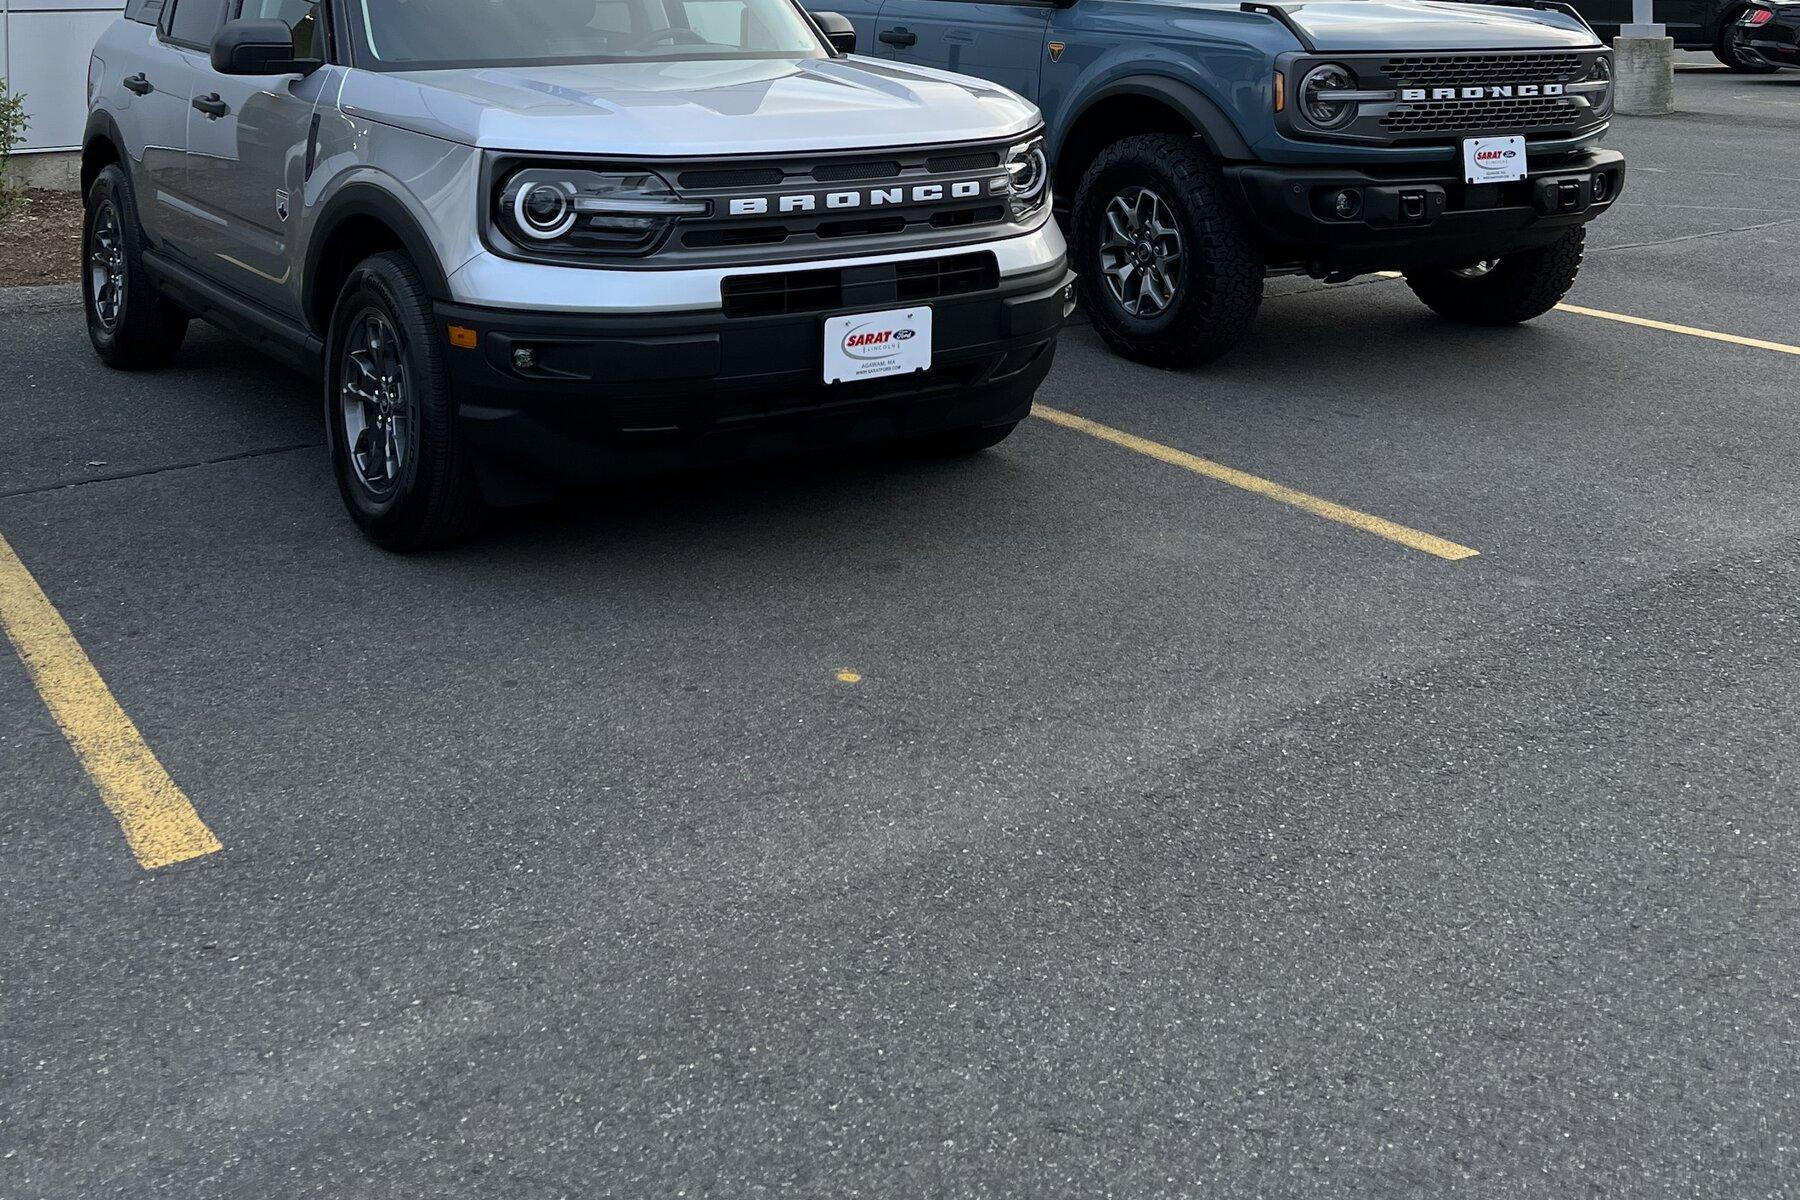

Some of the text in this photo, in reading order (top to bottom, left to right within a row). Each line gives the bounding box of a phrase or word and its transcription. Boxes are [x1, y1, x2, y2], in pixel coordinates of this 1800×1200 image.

[1401, 83, 1564, 101] BRONCO
[1477, 150, 1502, 160] SARAT
[729, 180, 981, 215] BRONCO
[847, 330, 914, 347] SARAT Ford
